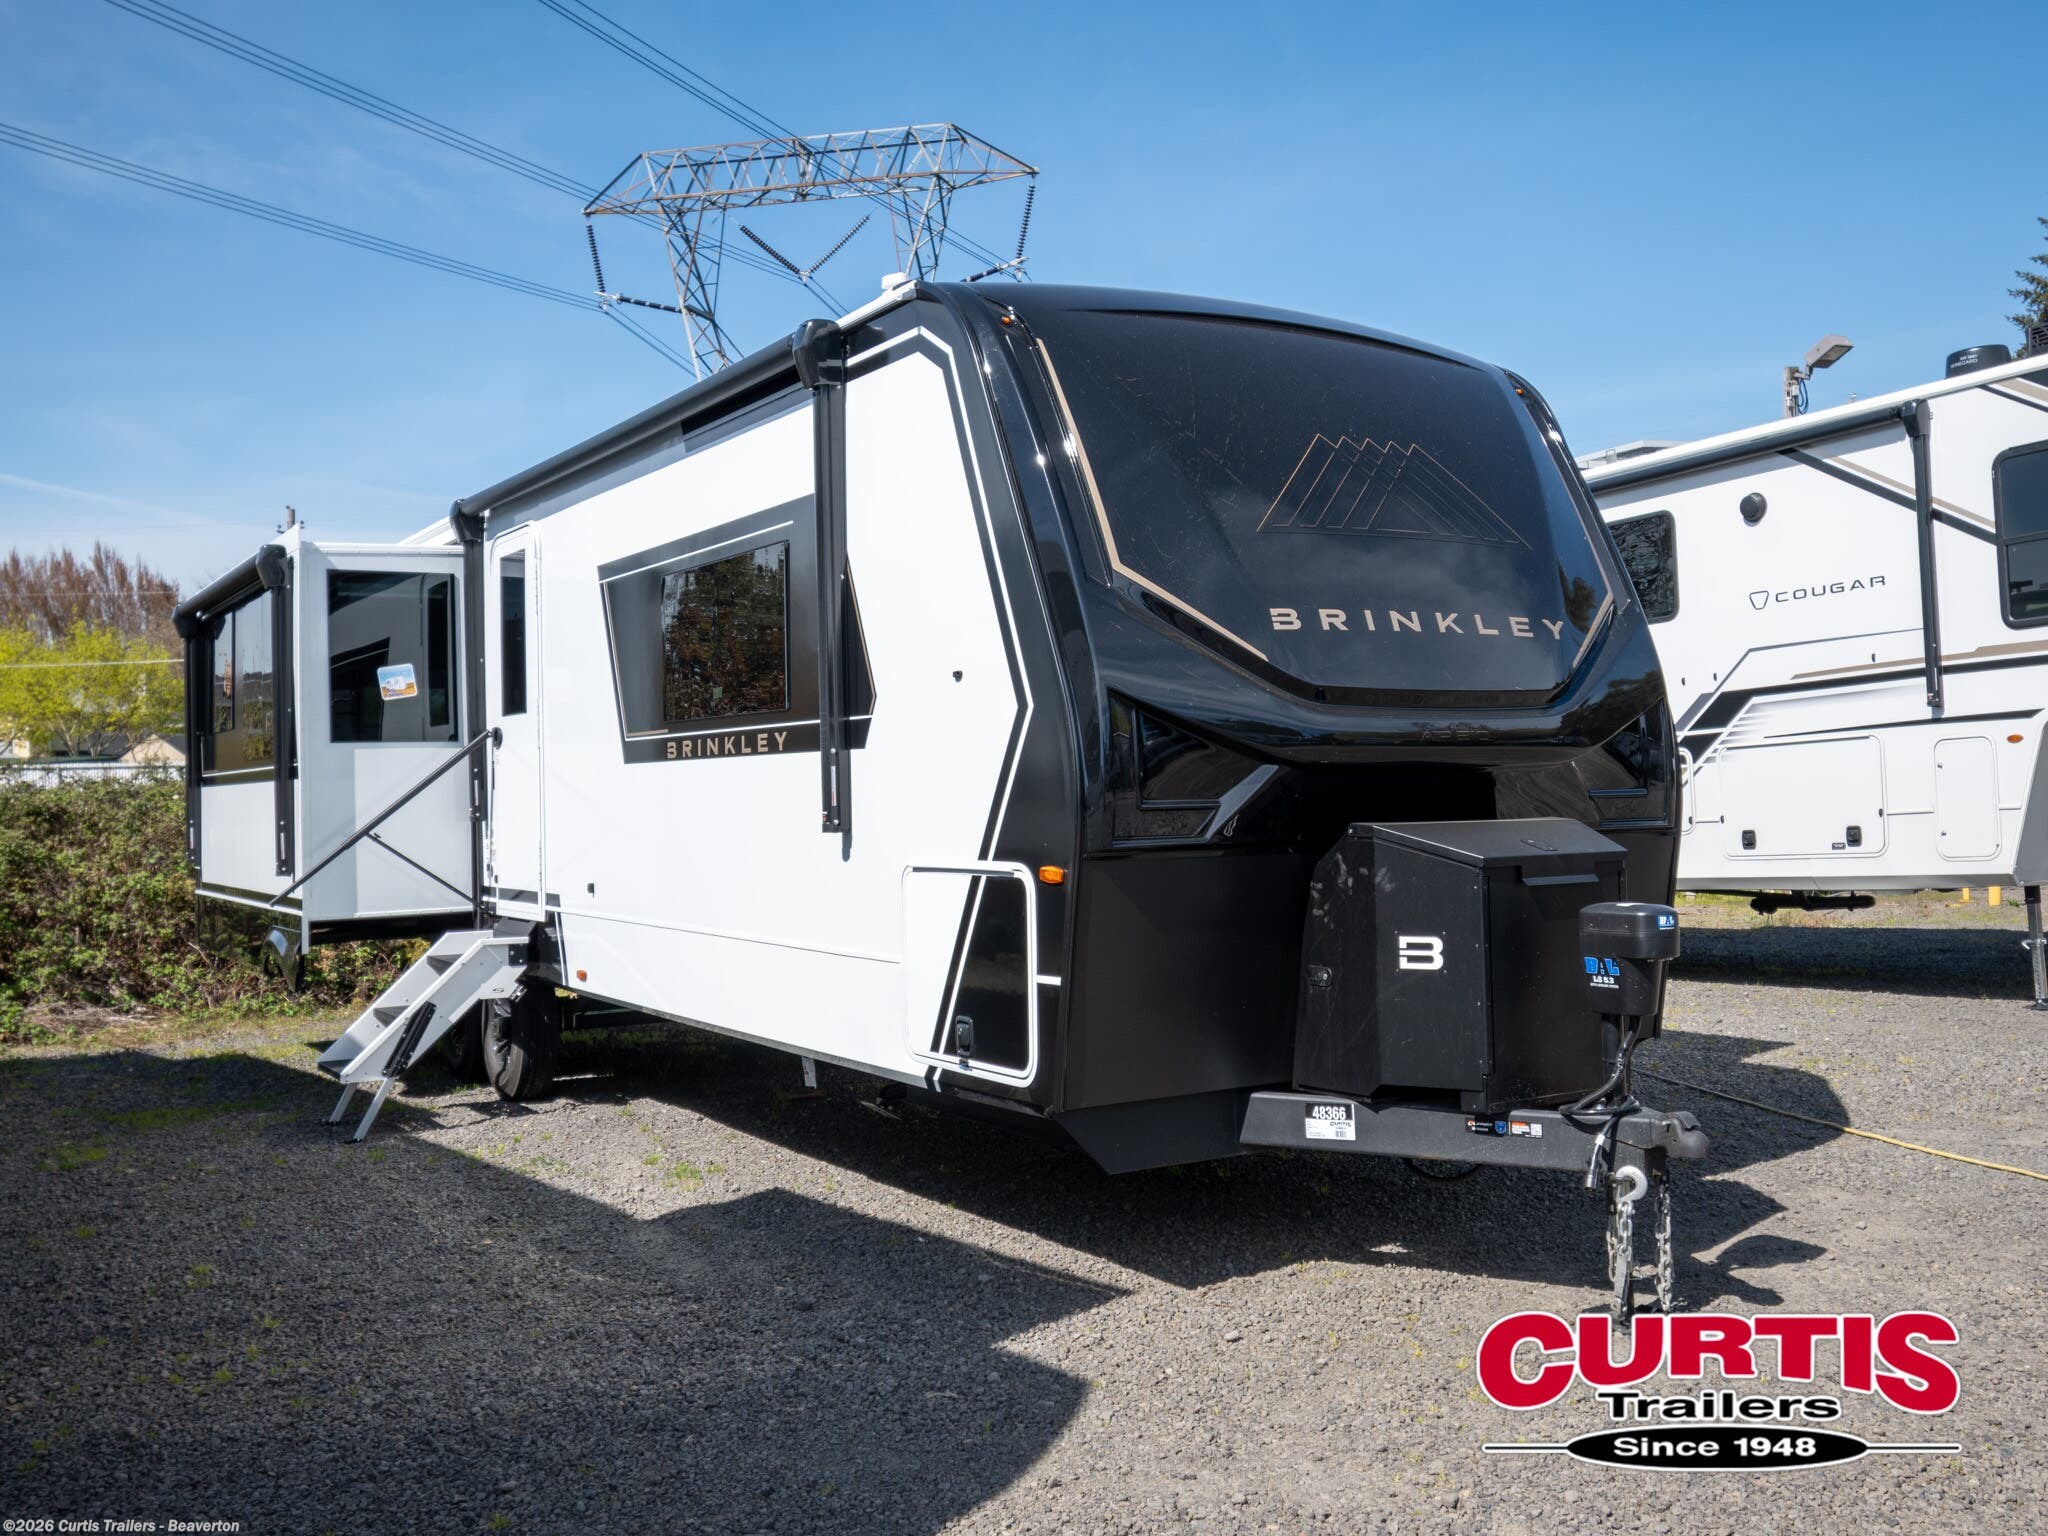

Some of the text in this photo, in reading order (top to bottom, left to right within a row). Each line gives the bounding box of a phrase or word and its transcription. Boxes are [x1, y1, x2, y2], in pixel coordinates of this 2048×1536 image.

[1775, 575, 1886, 603] COUGAR
[1269, 607, 1564, 641] BRINKLEY
[666, 731, 788, 759] BRINKLEY
[1312, 1105, 1347, 1120] 48366
